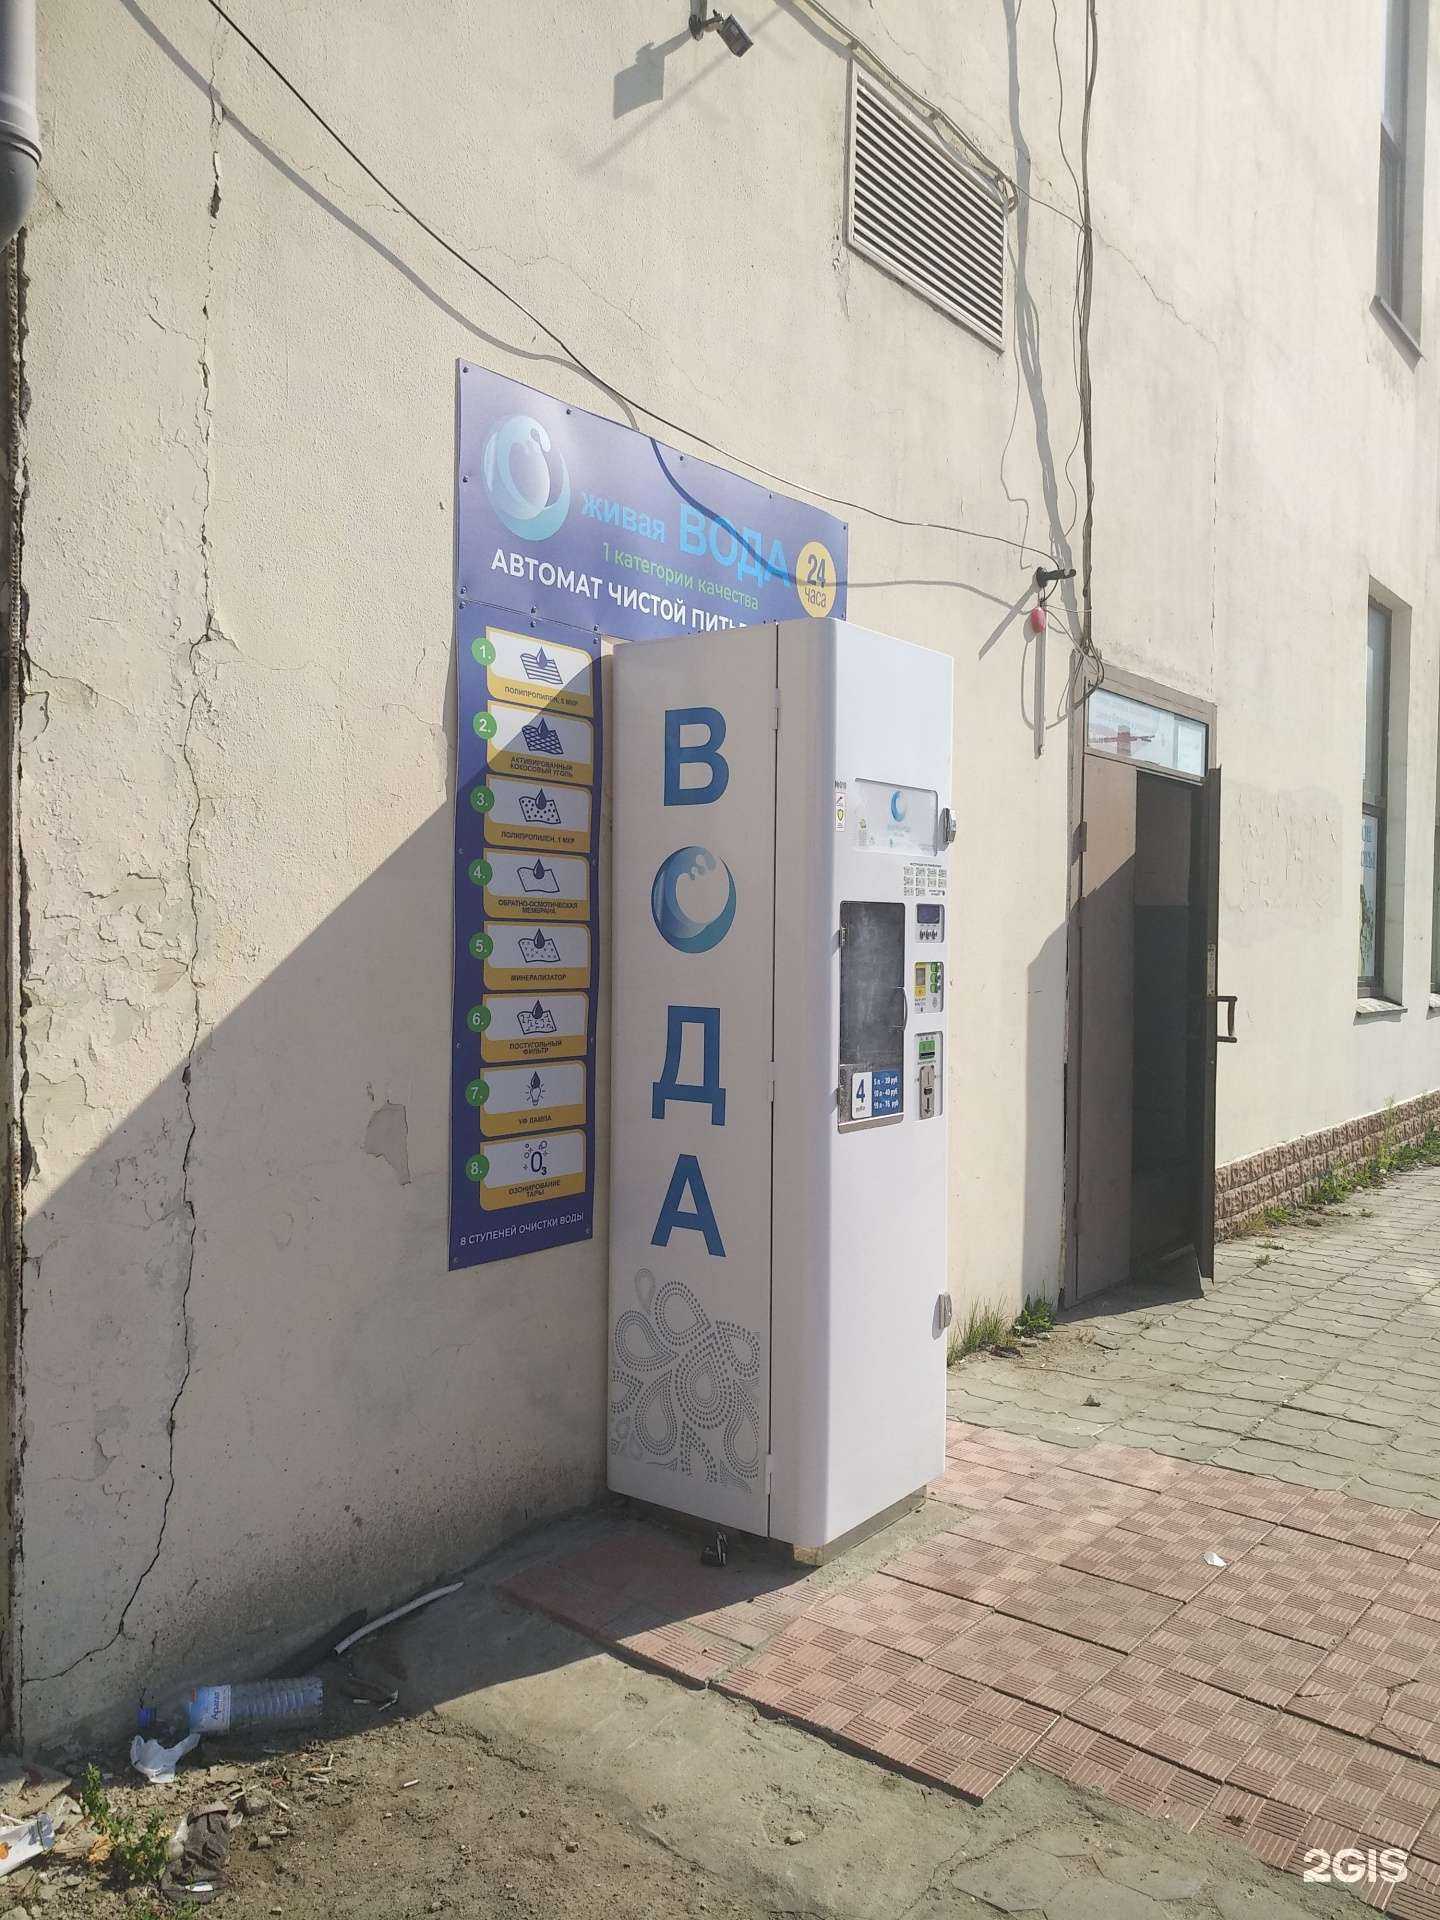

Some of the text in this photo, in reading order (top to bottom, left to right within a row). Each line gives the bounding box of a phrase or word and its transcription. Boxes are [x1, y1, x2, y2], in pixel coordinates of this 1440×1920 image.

[581, 491, 793, 589] живая ВОДА
[603, 543, 759, 610] 1 категории качества
[807, 554, 826, 588] 24
[491, 549, 602, 600] АВТОМАТ
[608, 581, 686, 626] ЧИСТОЙ
[805, 587, 827, 608] часа
[511, 974, 567, 982] МИНЕРАЛИЗАТОР
[856, 1078, 866, 1103] 4
[470, 1161, 483, 1175] 8.
[468, 1225, 517, 1244] СТУПЕНЕЙ
[519, 1217, 558, 1234] ОЧИСТКИ
[560, 1212, 584, 1225] ВОДЫ
